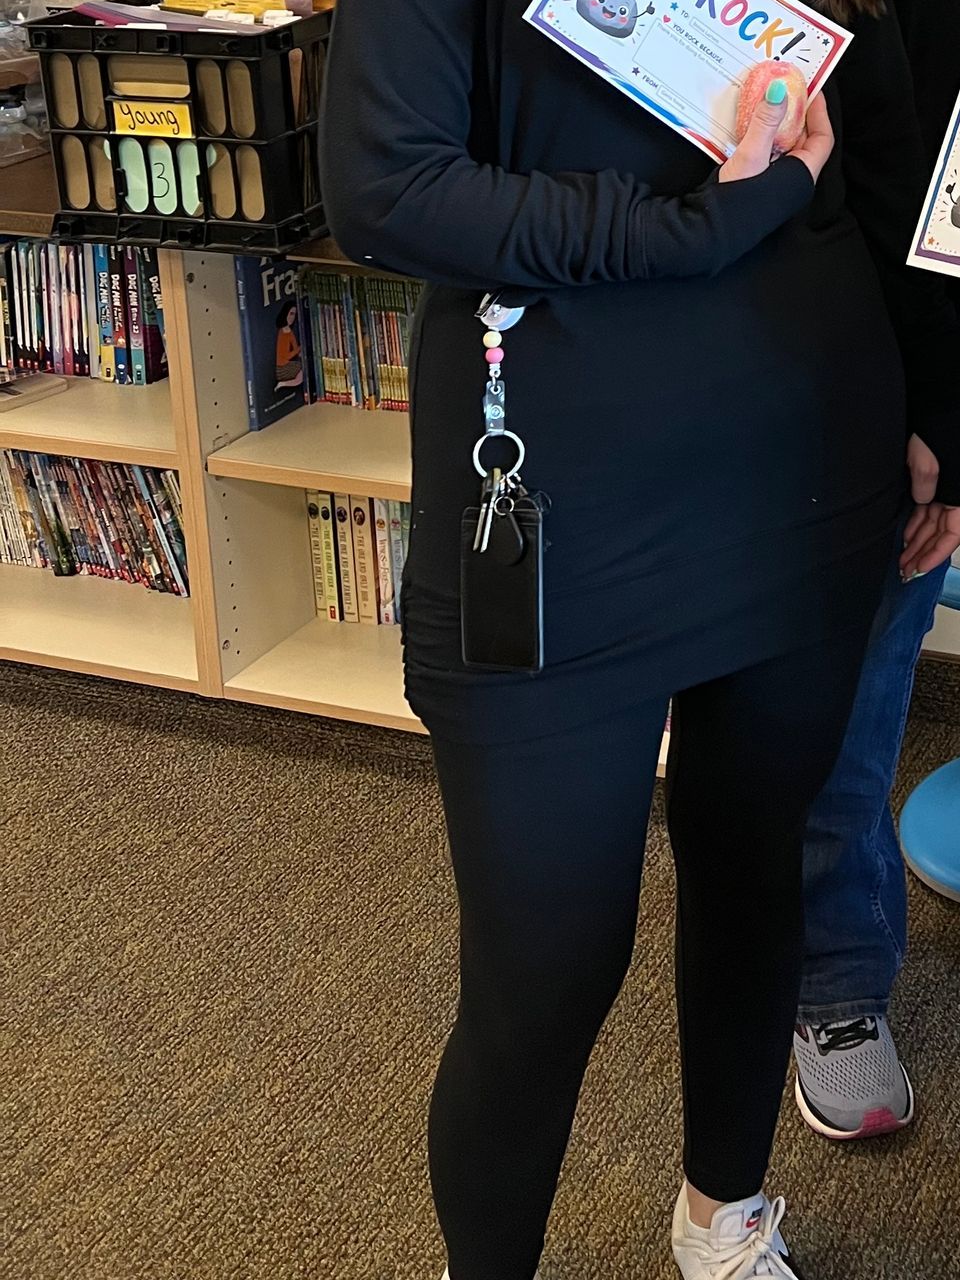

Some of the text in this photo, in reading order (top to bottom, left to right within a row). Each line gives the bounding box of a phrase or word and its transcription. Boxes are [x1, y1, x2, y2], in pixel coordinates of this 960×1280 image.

[672, 23, 684, 35] YOU
[684, 32, 699, 46] ROCK
[120, 103, 180, 135] Young
[153, 162, 170, 199] 3
[262, 268, 298, 307] Fra
